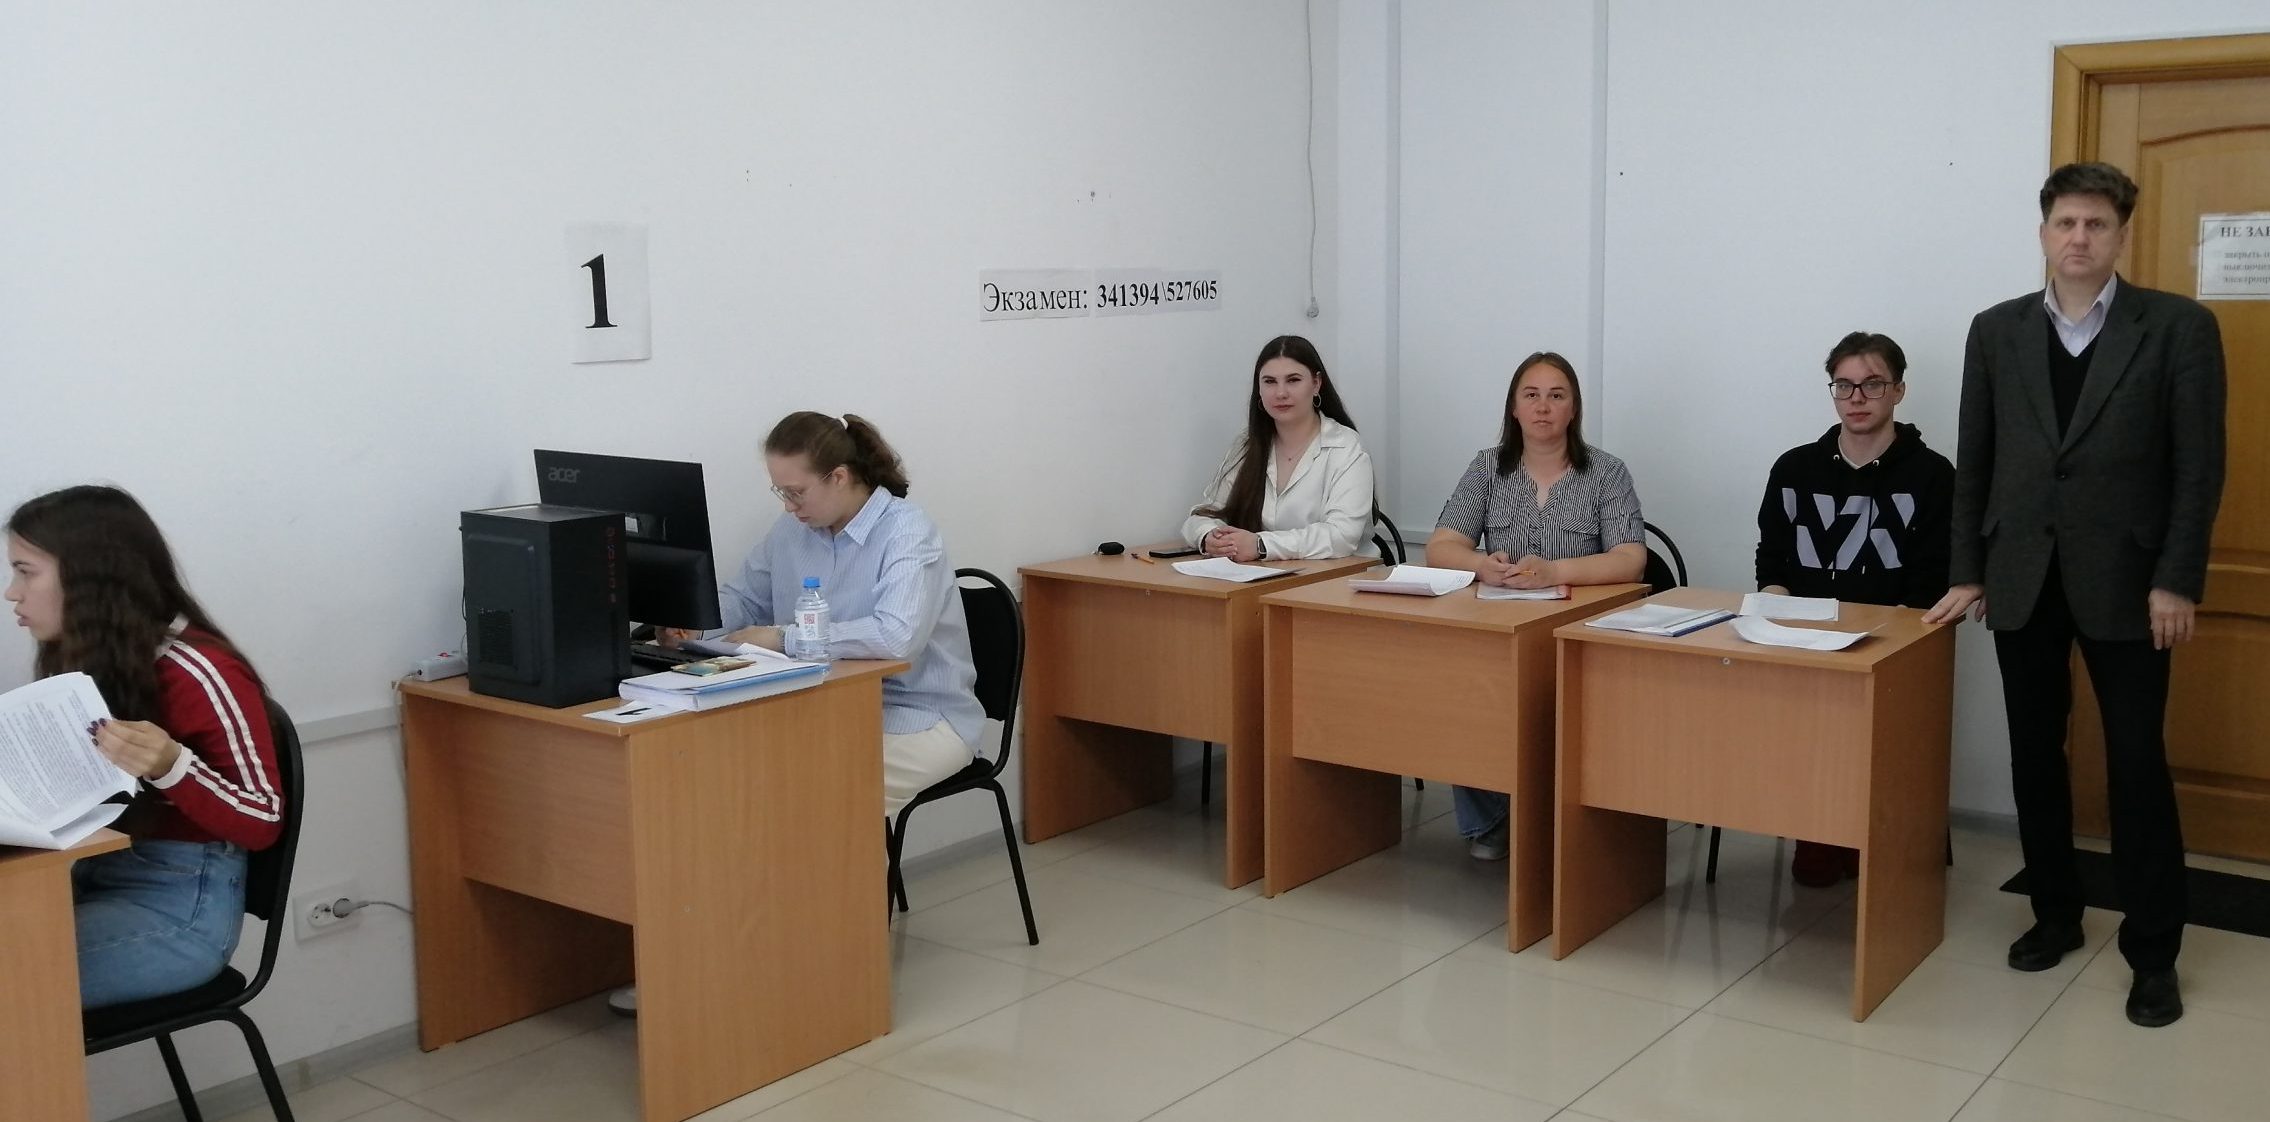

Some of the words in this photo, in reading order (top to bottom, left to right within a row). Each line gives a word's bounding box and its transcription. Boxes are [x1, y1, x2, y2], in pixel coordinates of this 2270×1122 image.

[2221, 226, 2242, 238] НЕ
[580, 253, 619, 329] 1
[983, 282, 1088, 312] Экзамен:
[1097, 280, 1217, 308] 341394\527605
[548, 466, 580, 483] acer
